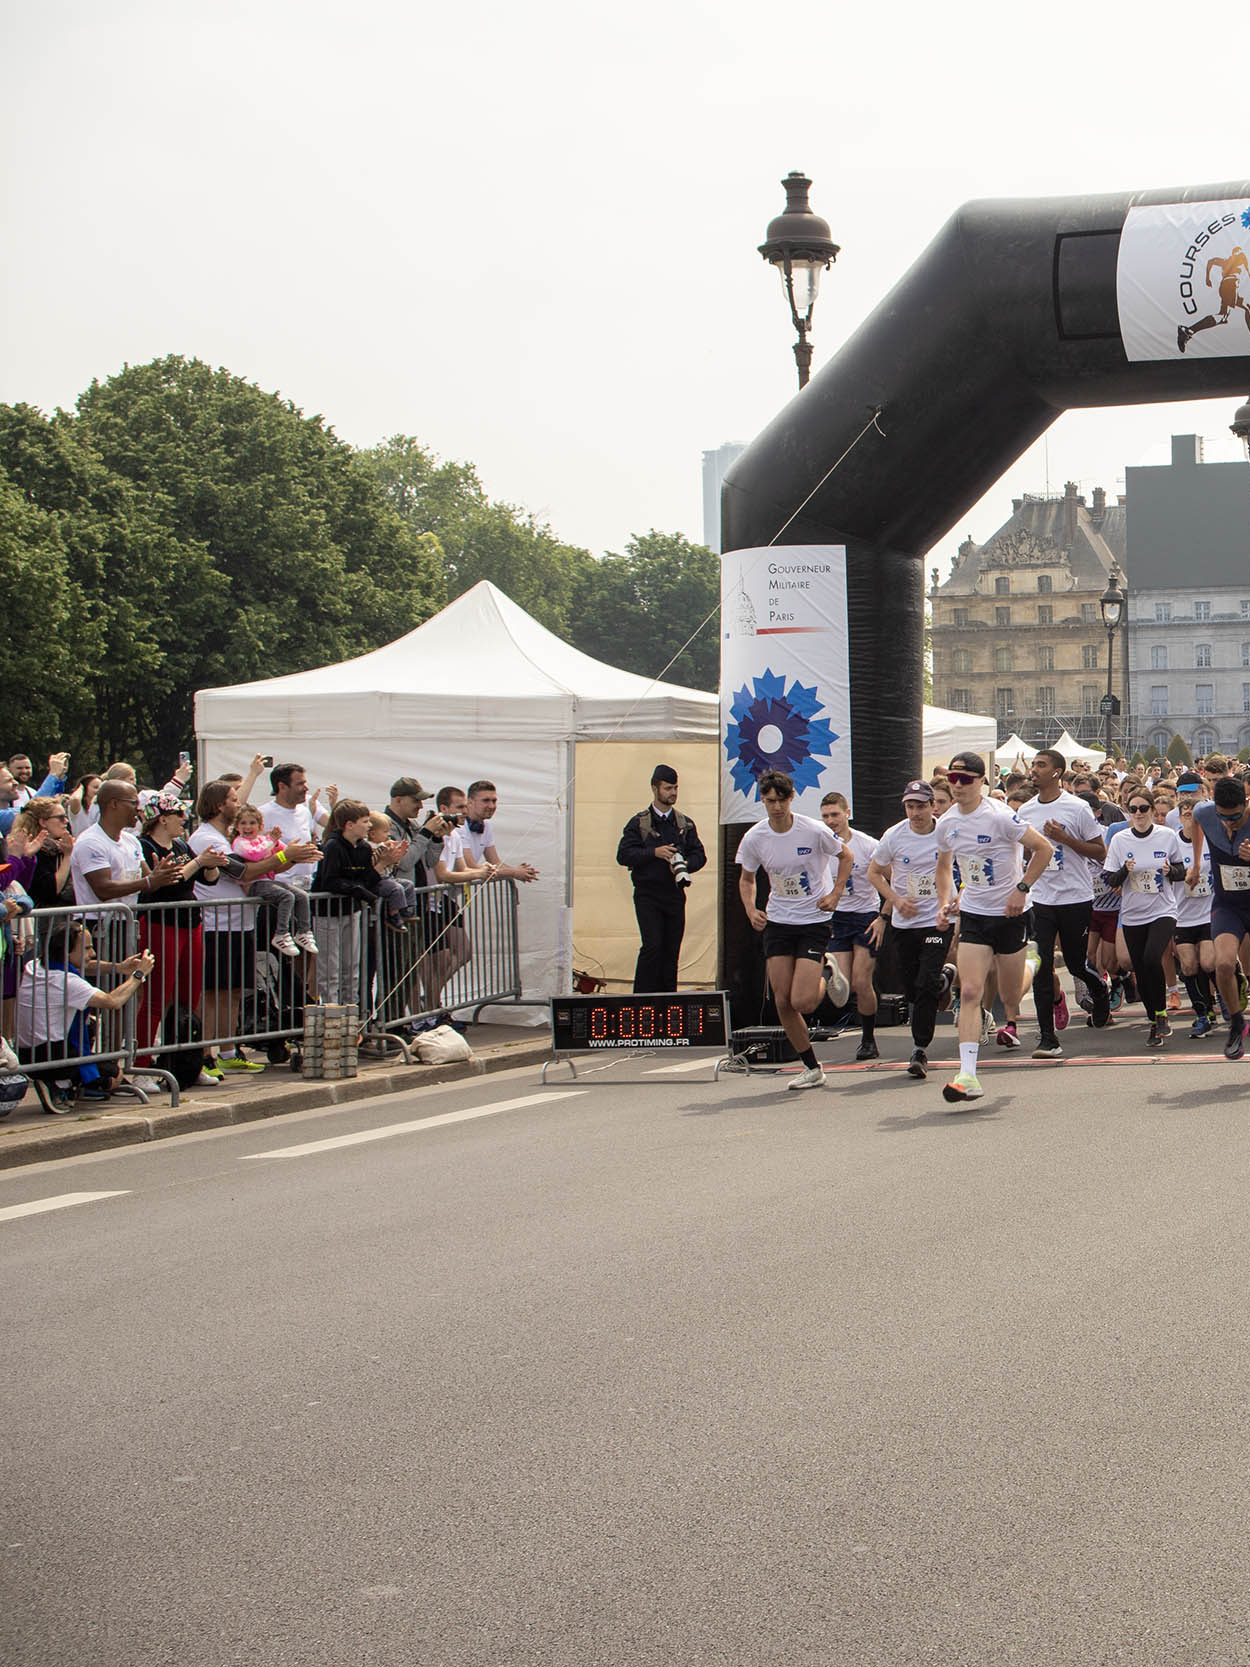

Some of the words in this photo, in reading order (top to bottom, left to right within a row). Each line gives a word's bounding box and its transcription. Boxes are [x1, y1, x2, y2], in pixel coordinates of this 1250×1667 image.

[1179, 213, 1236, 315] COURSES
[768, 563, 831, 575] GOUVERNEUR
[768, 579, 810, 590] MILITAIRE
[769, 598, 779, 606] DE
[769, 611, 794, 622] PARIS
[588, 1038, 690, 1048] WWW.PROTIMING.FR
